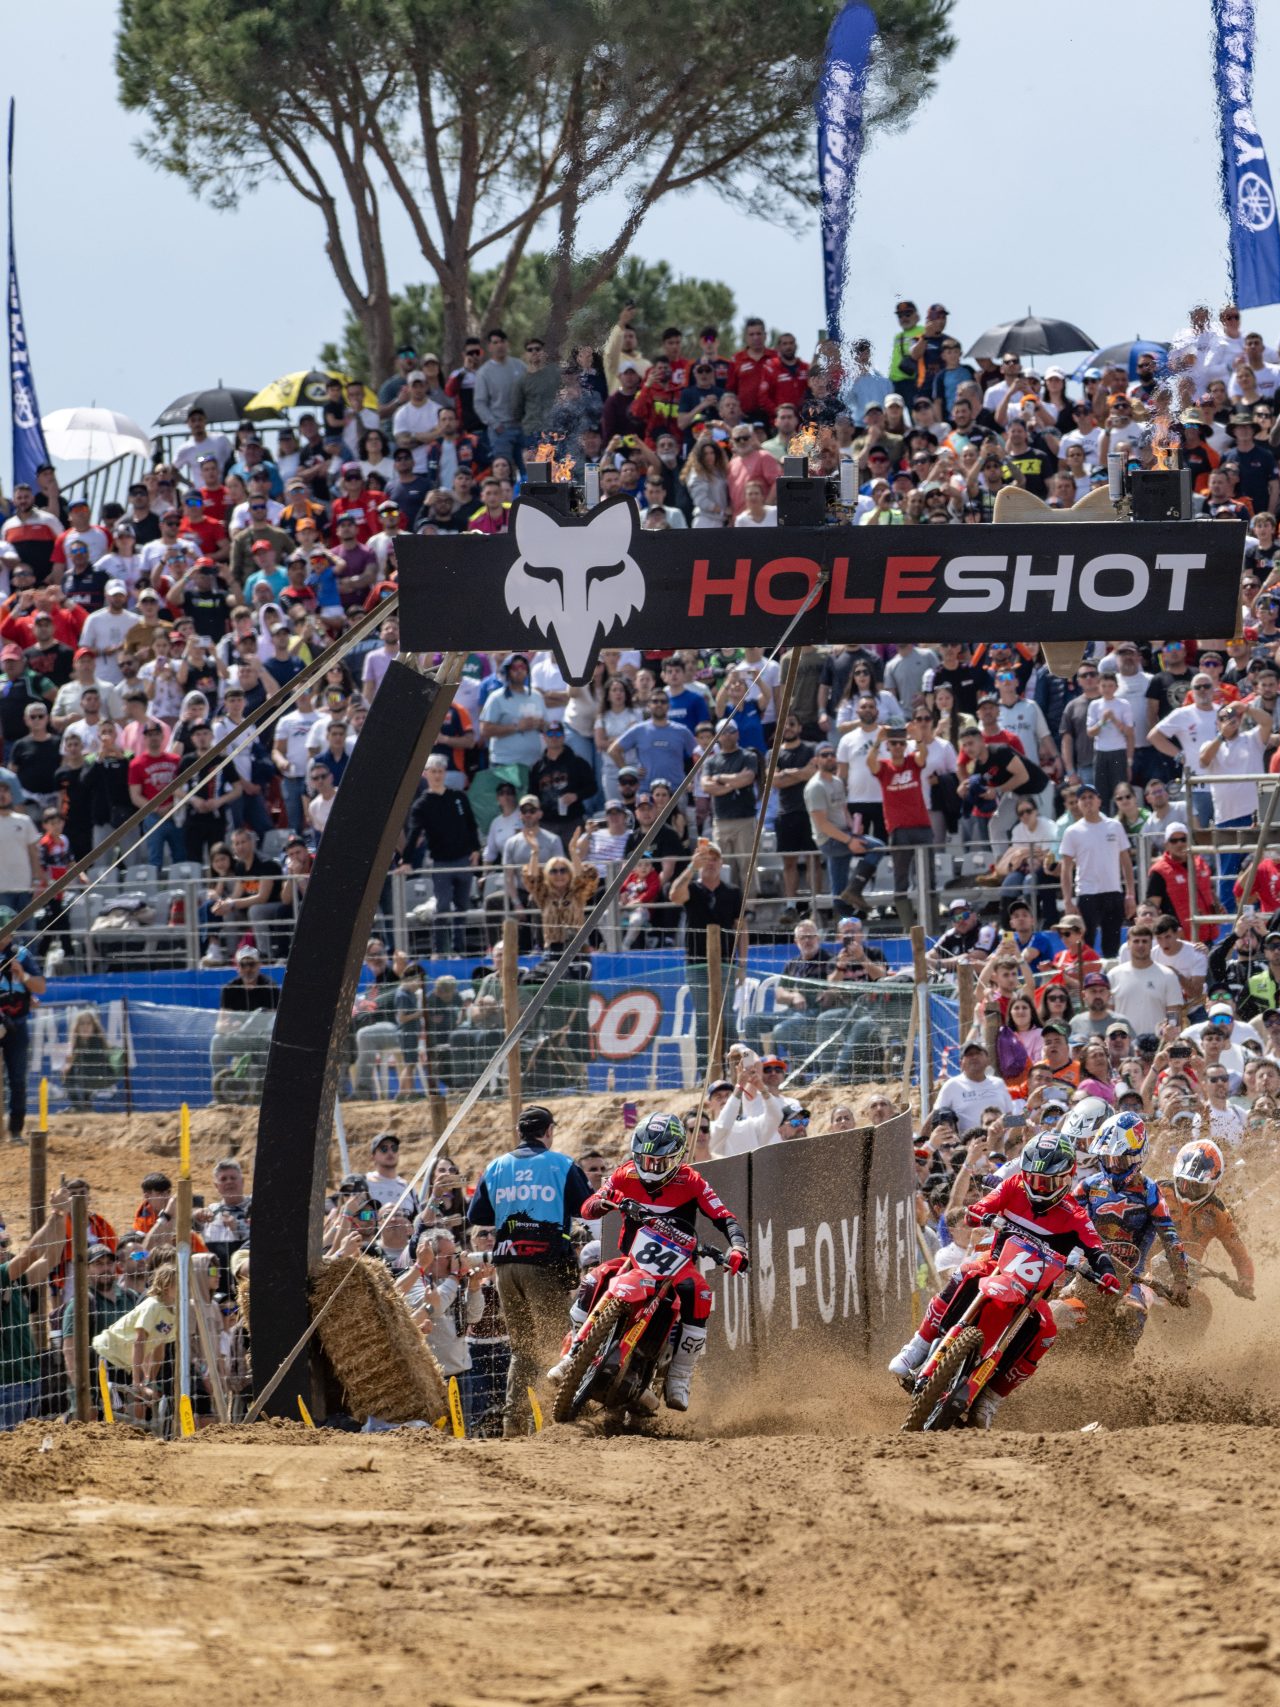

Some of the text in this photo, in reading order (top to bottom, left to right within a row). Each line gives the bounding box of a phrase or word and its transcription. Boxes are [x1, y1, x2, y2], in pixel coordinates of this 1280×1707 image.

[687, 553, 1206, 617] HOLESHOT
[515, 1169, 534, 1182] 22
[495, 1184, 556, 1204] PHOTO
[635, 1241, 680, 1275] 84
[787, 1214, 862, 1331] FOX
[1003, 1250, 1050, 1283] 16
